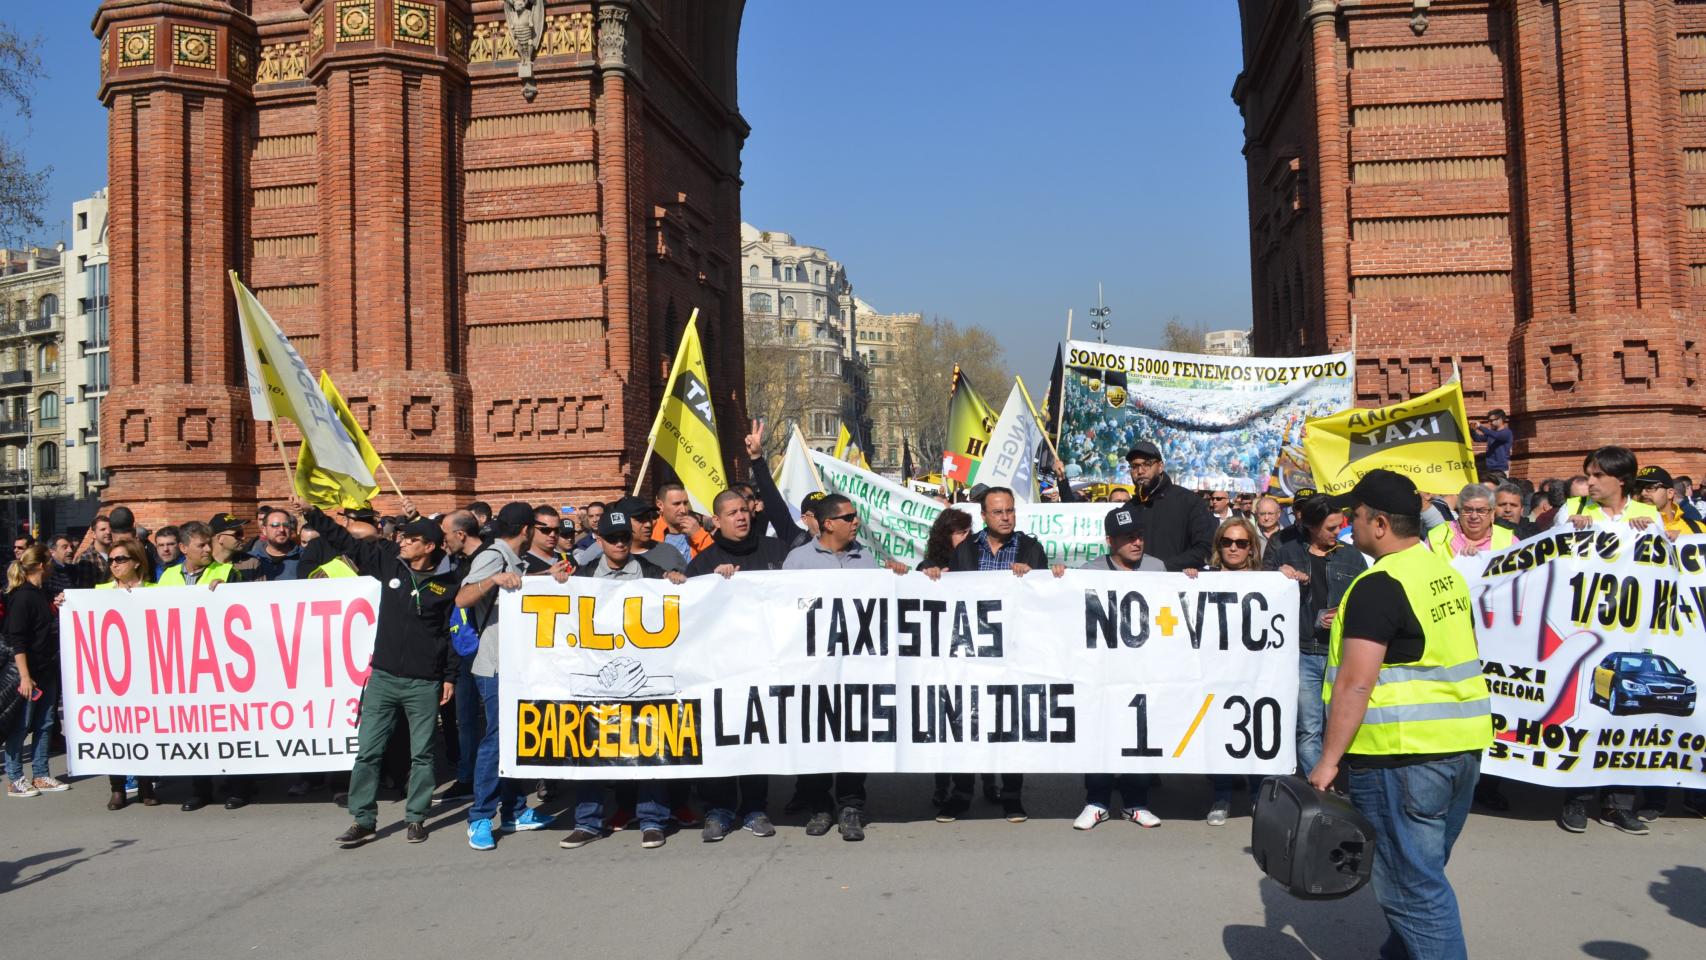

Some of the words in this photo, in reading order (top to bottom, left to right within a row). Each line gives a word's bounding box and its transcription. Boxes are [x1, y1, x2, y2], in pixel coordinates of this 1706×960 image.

[1070, 348, 1126, 371] SOMOS
[1130, 356, 1170, 375] 15000
[1172, 361, 1252, 380] TENEMOS
[1254, 366, 1288, 382] VOZ
[1288, 366, 1301, 380] Y
[1302, 361, 1347, 379] VOTO
[1361, 415, 1441, 447] TAXI
[692, 453, 707, 470] de
[707, 466, 728, 491] Tax
[1323, 479, 1356, 495] Nova
[1426, 461, 1442, 474] de
[1482, 530, 1621, 577] RESPETO
[1429, 575, 1454, 597] STAFF
[1569, 571, 1640, 628] 1/30
[521, 594, 681, 651] T.L.U
[798, 596, 1004, 658] TAXISTAS
[1430, 601, 1456, 624] ELITE
[1453, 596, 1469, 612] AXI
[72, 609, 132, 697] NO
[145, 604, 257, 695] MAS
[271, 597, 375, 690] VTC
[1479, 659, 1547, 684] AXI
[1488, 679, 1545, 702] RCELONA
[78, 701, 295, 734] CUMPLIMIENTO
[517, 701, 699, 759] BARCELONA
[713, 683, 897, 747] LATINOS
[911, 683, 1076, 744] UNIDOS
[78, 741, 149, 761] RADIO
[155, 741, 209, 760] TAXI
[219, 740, 269, 759] DEL
[276, 736, 359, 758] VALLE
[1516, 717, 1590, 752] HOY
[1597, 728, 1625, 747] NO
[1630, 723, 1673, 747] MÁS
[1593, 750, 1693, 769] DESLEAL
